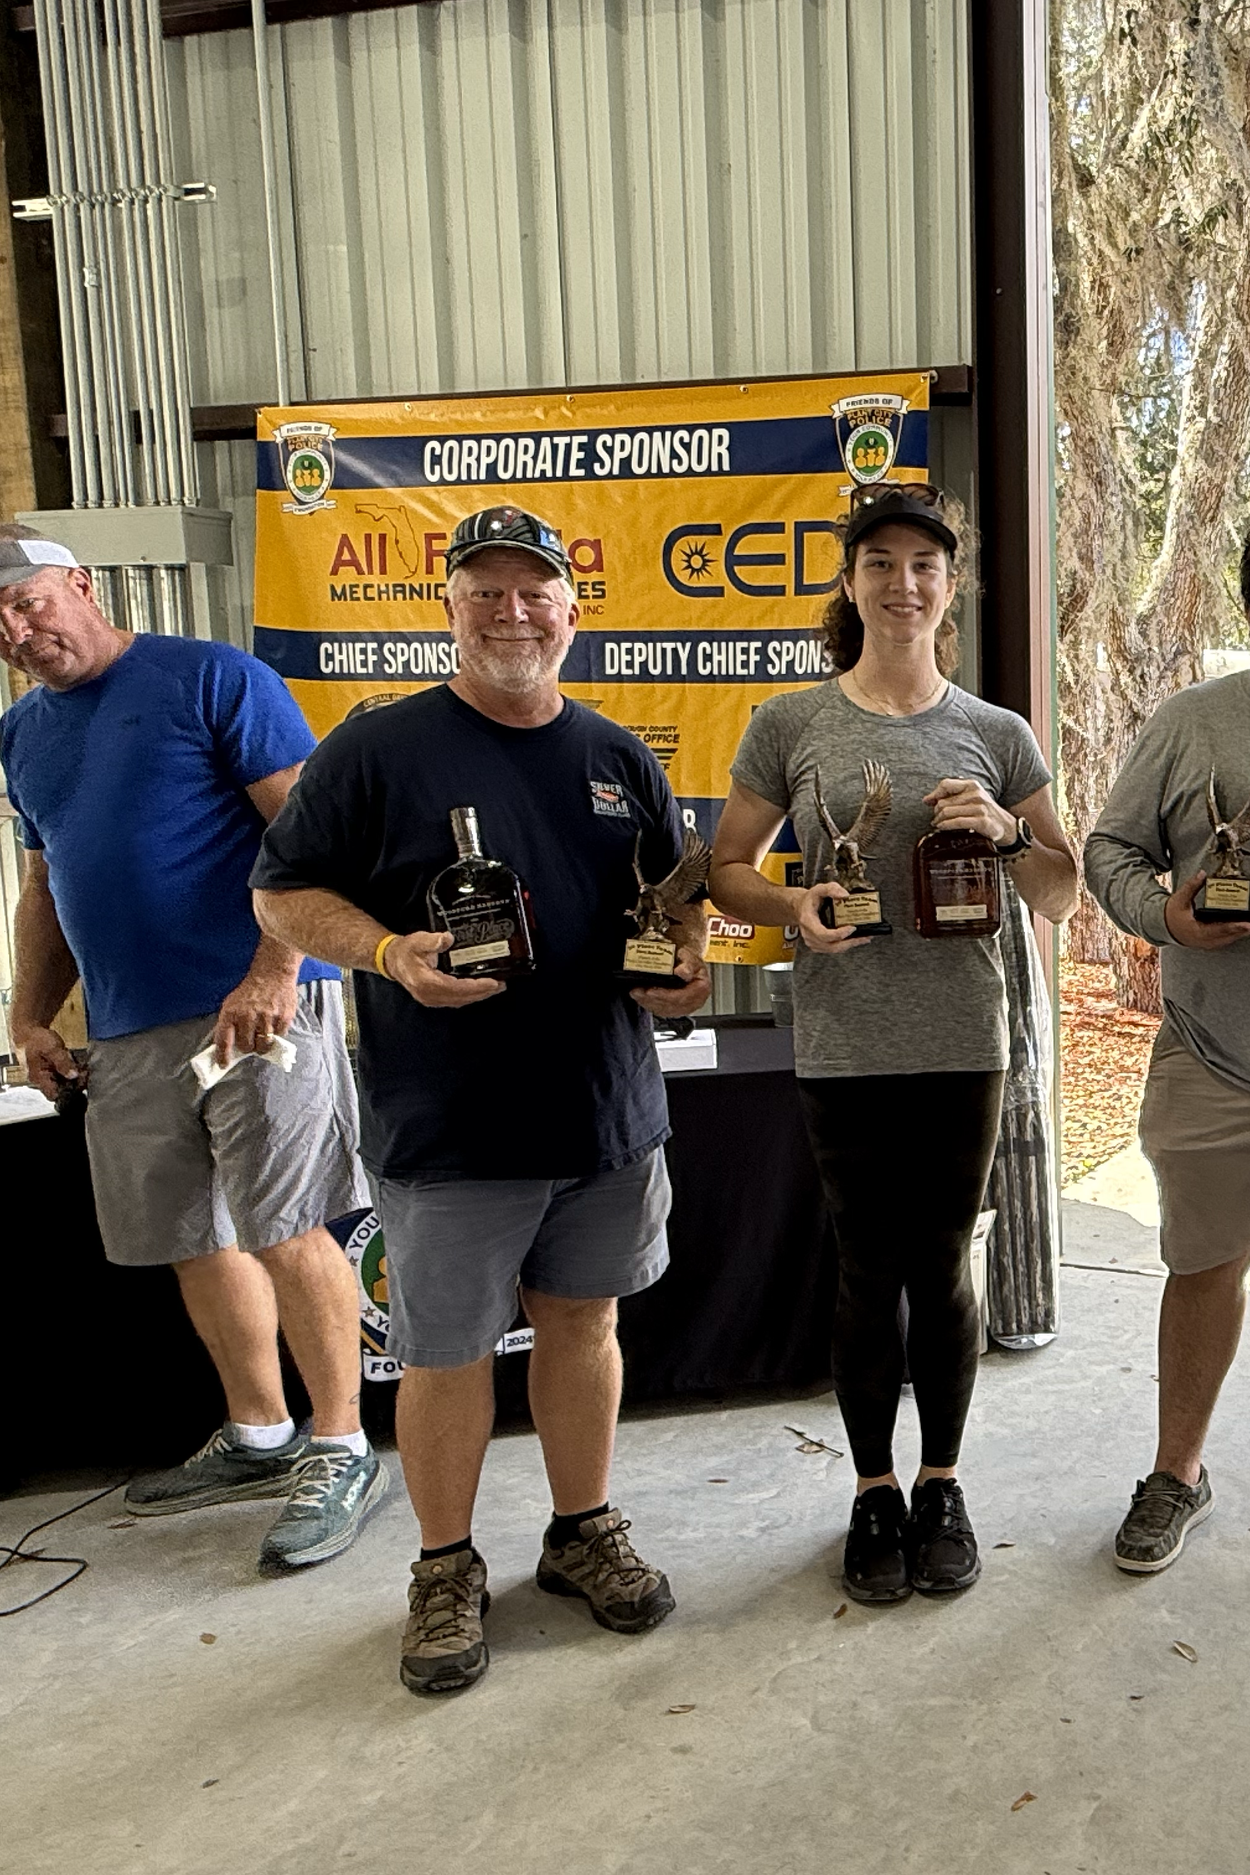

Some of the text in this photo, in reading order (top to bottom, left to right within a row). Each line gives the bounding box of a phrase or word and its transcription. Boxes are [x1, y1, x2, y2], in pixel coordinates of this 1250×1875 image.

[848, 415, 893, 429] POLICE
[423, 428, 731, 482] CORPORATE SPONSOR
[329, 533, 388, 576] All
[662, 520, 846, 598] CED
[329, 582, 447, 602] MECHANIC
[582, 604, 605, 615] INC
[319, 641, 461, 675] CHIEF SPONSO
[604, 642, 691, 676] DEPUTY
[697, 641, 763, 676] CHIEF
[643, 733, 680, 744] OFFICE
[590, 781, 624, 798] SILVER
[349, 1215, 381, 1250] YOU
[506, 1335, 534, 1348] 2024
